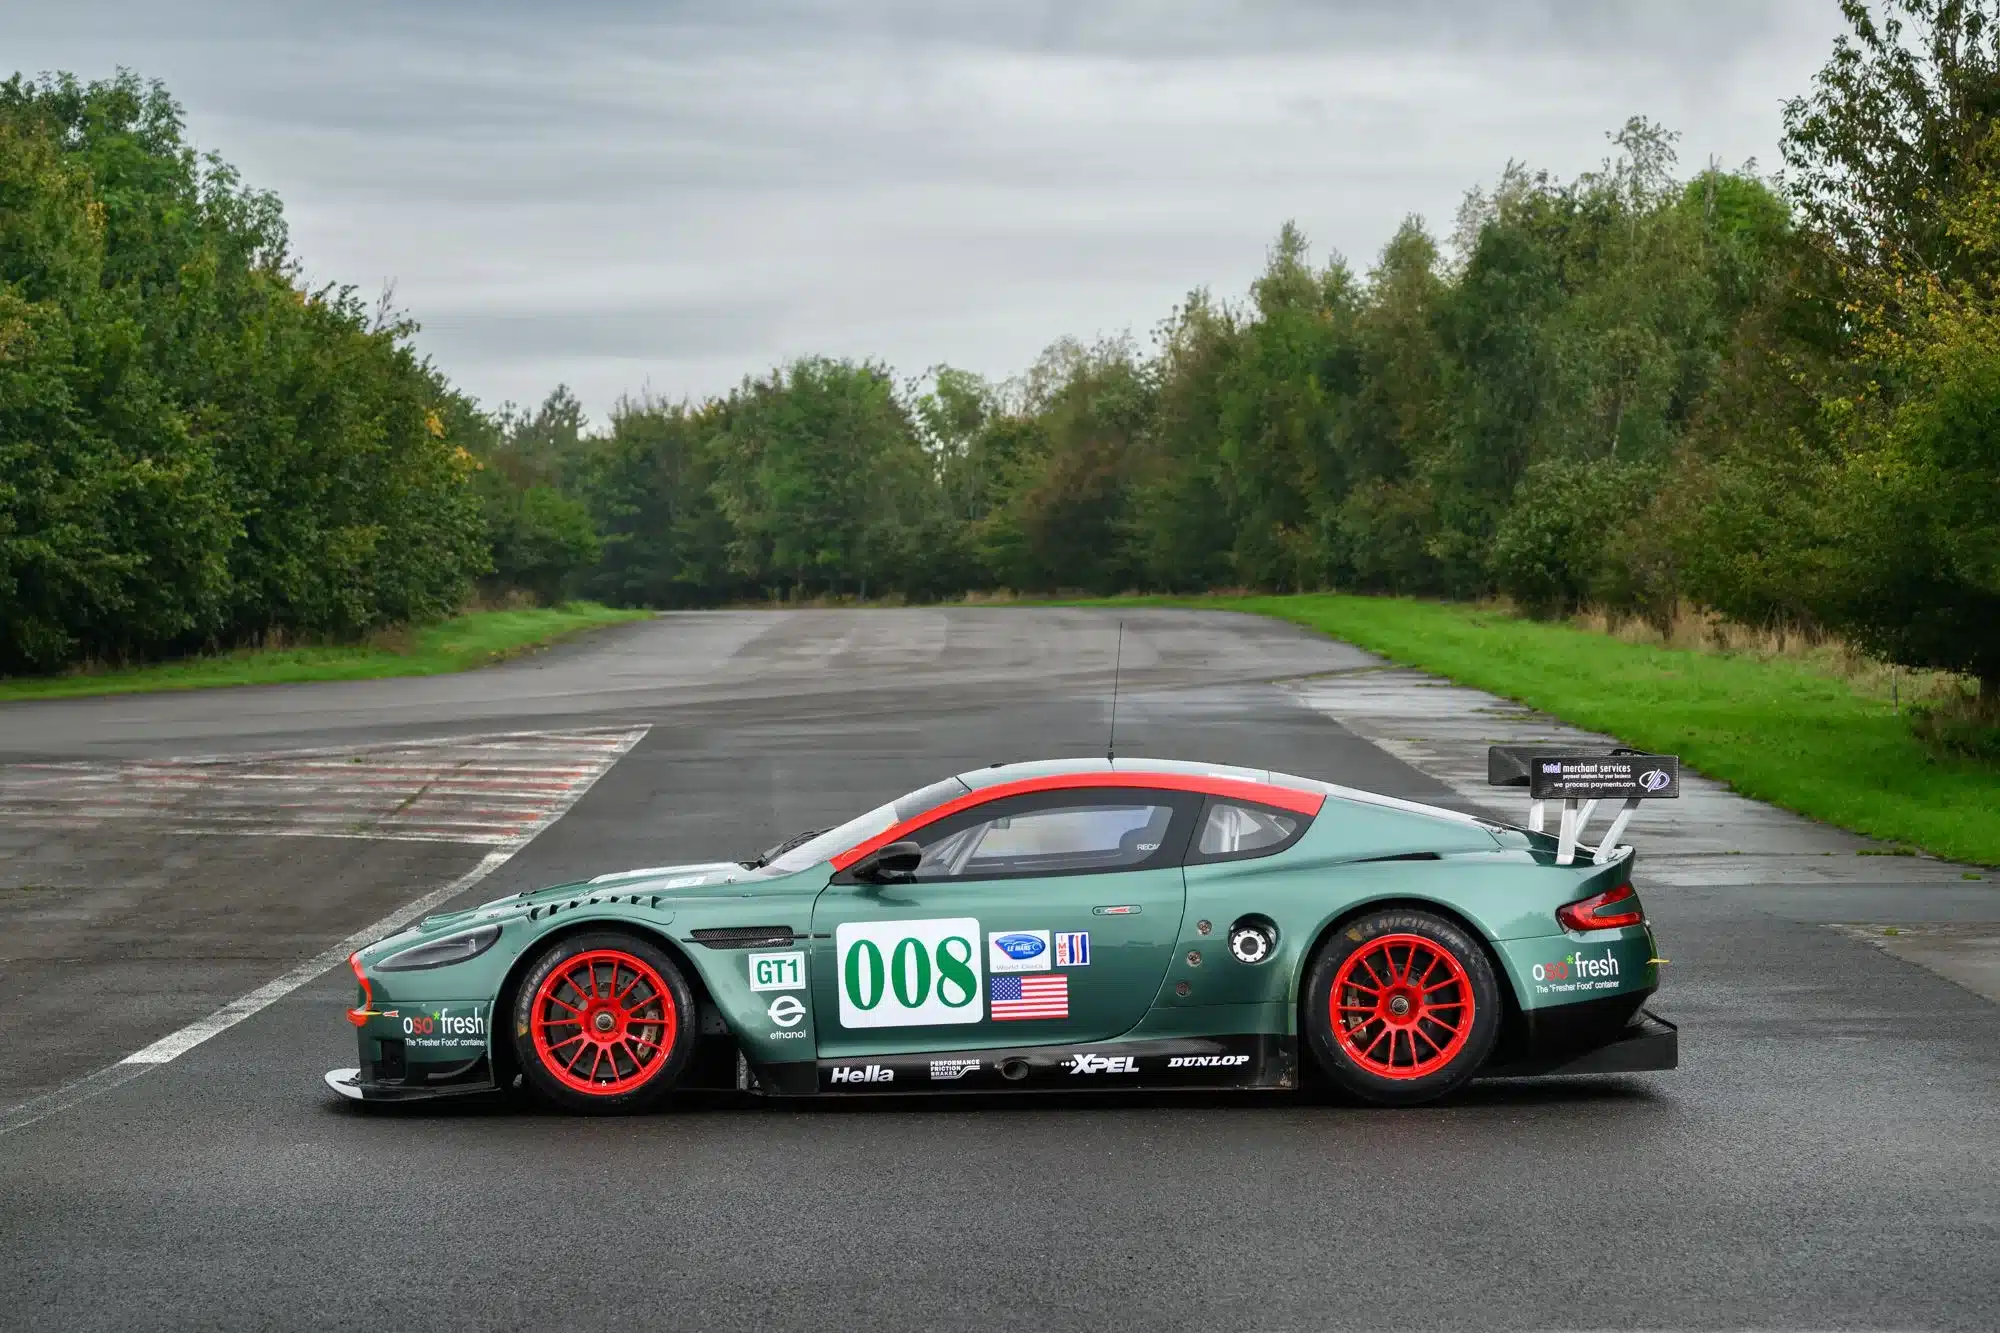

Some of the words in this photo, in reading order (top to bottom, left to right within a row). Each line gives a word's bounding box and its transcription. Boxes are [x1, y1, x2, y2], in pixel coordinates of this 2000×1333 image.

[1563, 762, 1598, 773] merchant
[1600, 763, 1631, 773] services
[1591, 781, 1636, 789] payments.com
[757, 958, 799, 985] GT1
[845, 936, 977, 1011] 008
[1536, 985, 1549, 993] The
[1595, 980, 1619, 989] container
[770, 1029, 806, 1040] ethanol
[405, 1038, 416, 1046] The
[930, 1058, 980, 1066] PERFORMANCE
[1069, 1053, 1140, 1075] XPEL
[1167, 1055, 1250, 1068] DUNLOP
[830, 1064, 895, 1084] Hella
